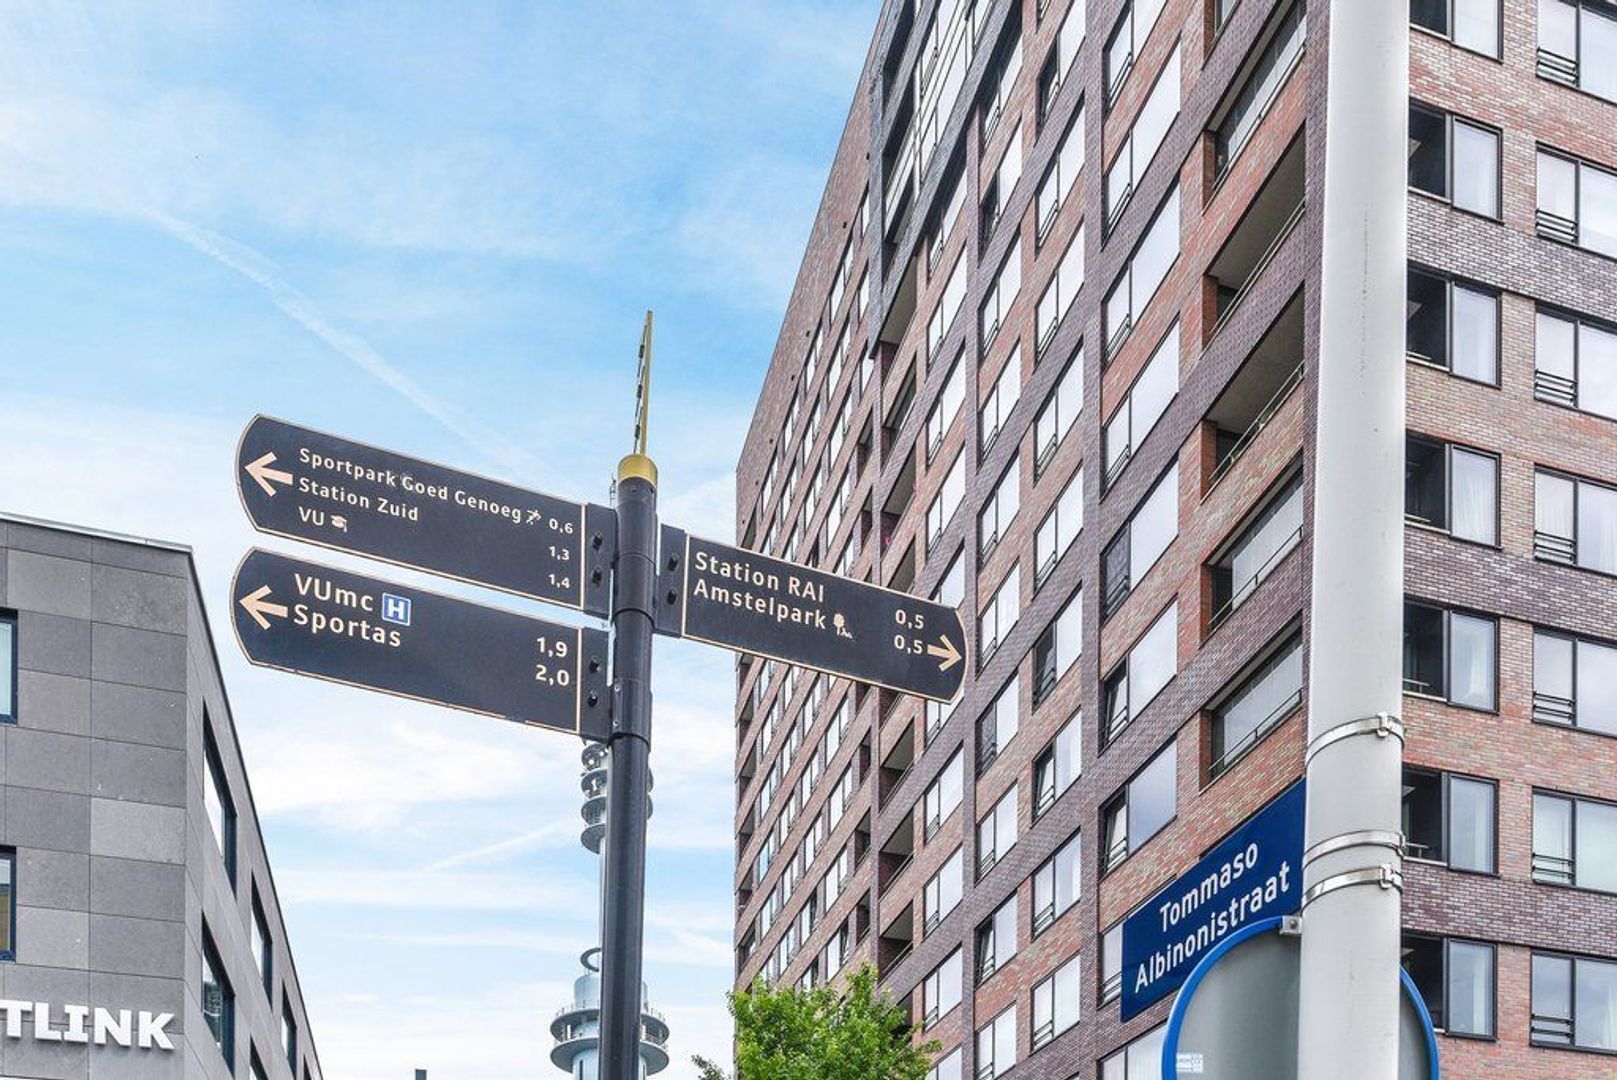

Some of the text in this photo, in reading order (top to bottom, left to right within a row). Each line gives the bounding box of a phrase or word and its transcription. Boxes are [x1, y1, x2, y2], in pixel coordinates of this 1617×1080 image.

[298, 477, 570, 561] Station Zuid 1,3
[299, 448, 574, 534] Sportpark Goed Genoeg 0,6
[298, 506, 570, 589] VU 1,4
[294, 573, 568, 658] VUmc H 1,9
[693, 578, 924, 655] Amstelpark 0,5
[695, 551, 925, 630] Station RAI 0,5
[293, 605, 570, 686] Sportas 2,0
[1134, 861, 1290, 994] Albinonistraat
[1160, 842, 1258, 932] Tommaso
[0, 1000, 175, 1050] TLINK
